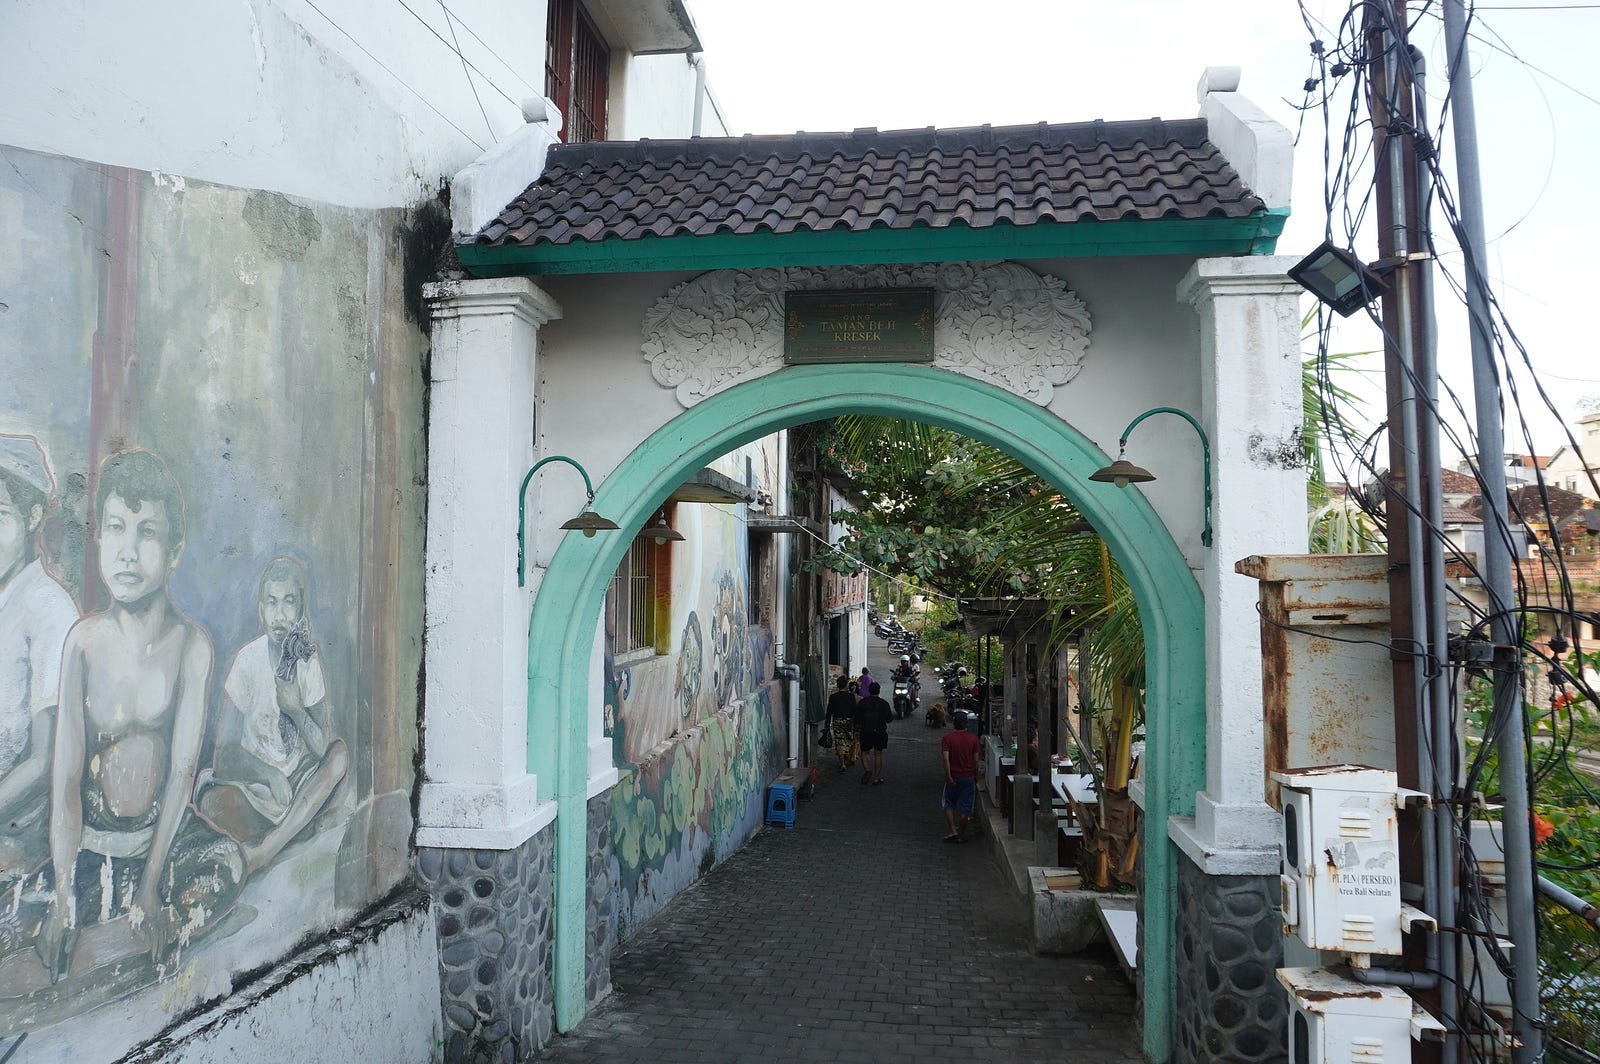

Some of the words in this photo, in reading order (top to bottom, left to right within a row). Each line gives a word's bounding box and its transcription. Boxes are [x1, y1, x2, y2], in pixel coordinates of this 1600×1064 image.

[820, 321, 865, 332] TAMAN
[834, 332, 881, 342] KRESEK
[1343, 874, 1356, 884] PLN
[1354, 887, 1367, 896] Bali
[1368, 888, 1392, 897] Selatan
